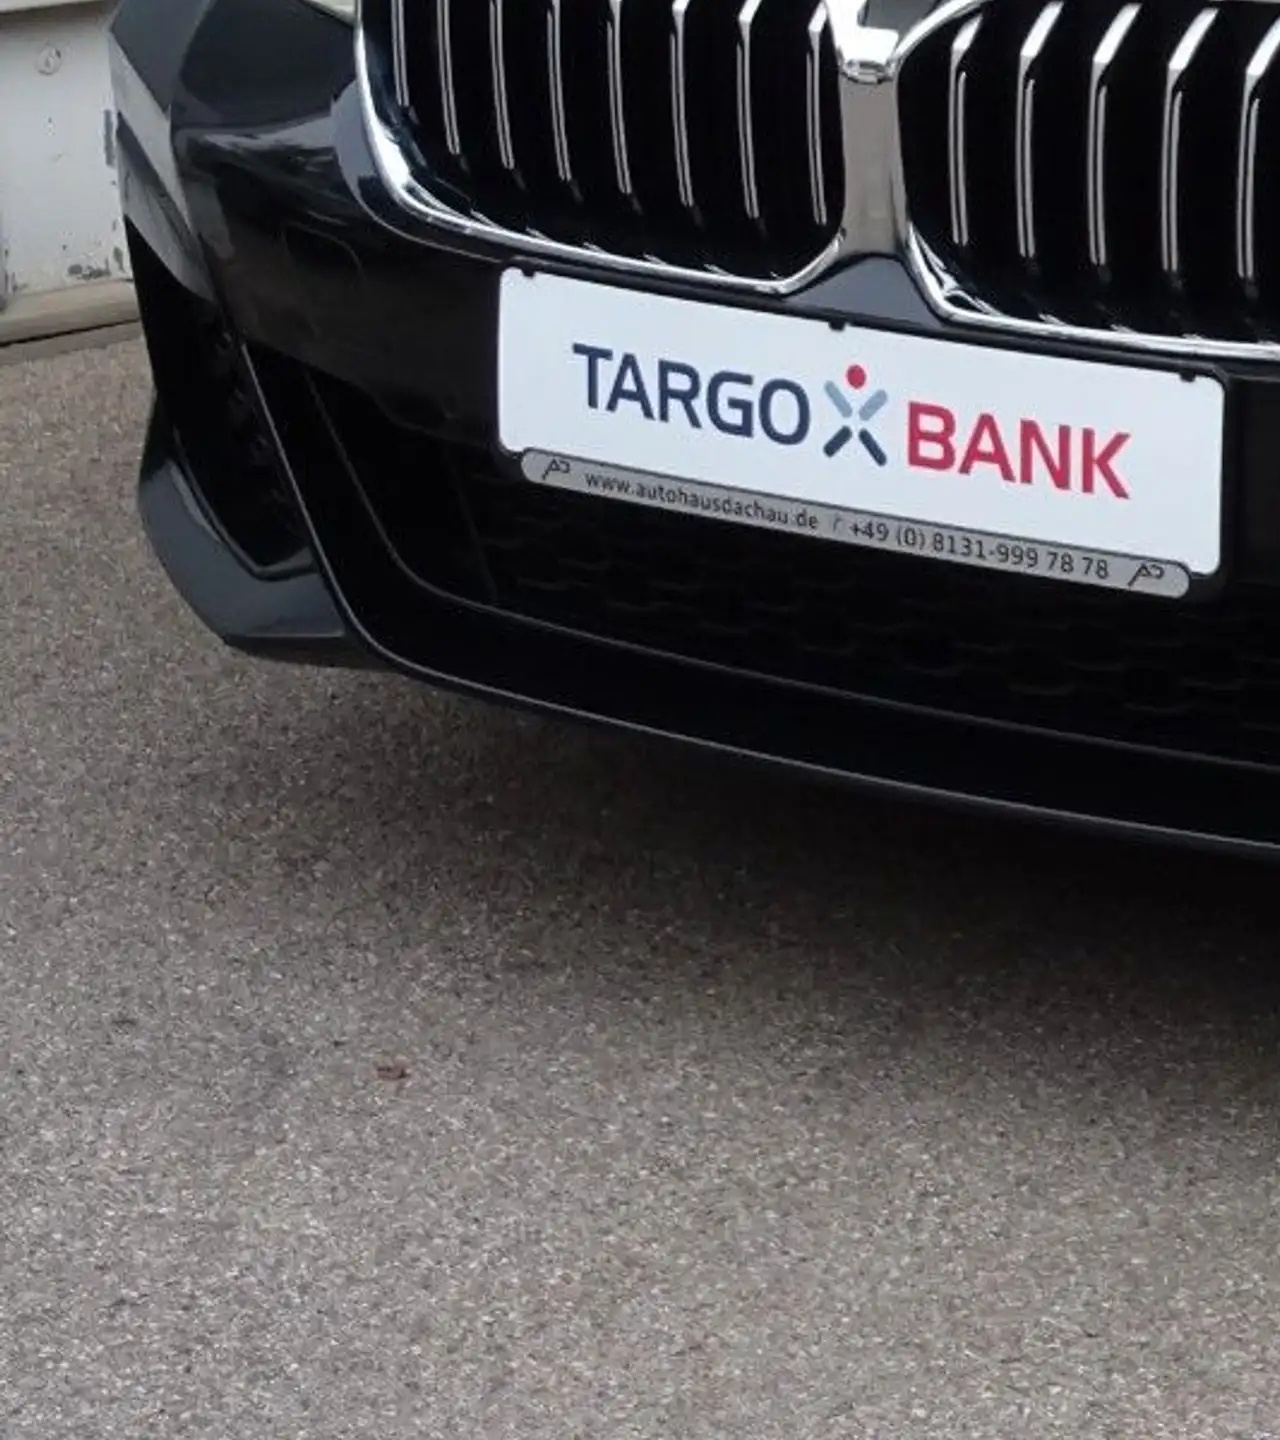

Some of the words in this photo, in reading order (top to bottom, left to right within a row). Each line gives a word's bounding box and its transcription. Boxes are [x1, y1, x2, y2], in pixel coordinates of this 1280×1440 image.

[571, 342, 812, 446] TARGO
[906, 401, 1132, 500] BANK
[584, 471, 819, 530] www.autohausdachau.de
[851, 520, 889, 542] +49
[896, 526, 926, 551] (0)
[932, 532, 1040, 568] 8131-999
[1047, 551, 1075, 575] 78
[1082, 555, 1110, 579] 78
